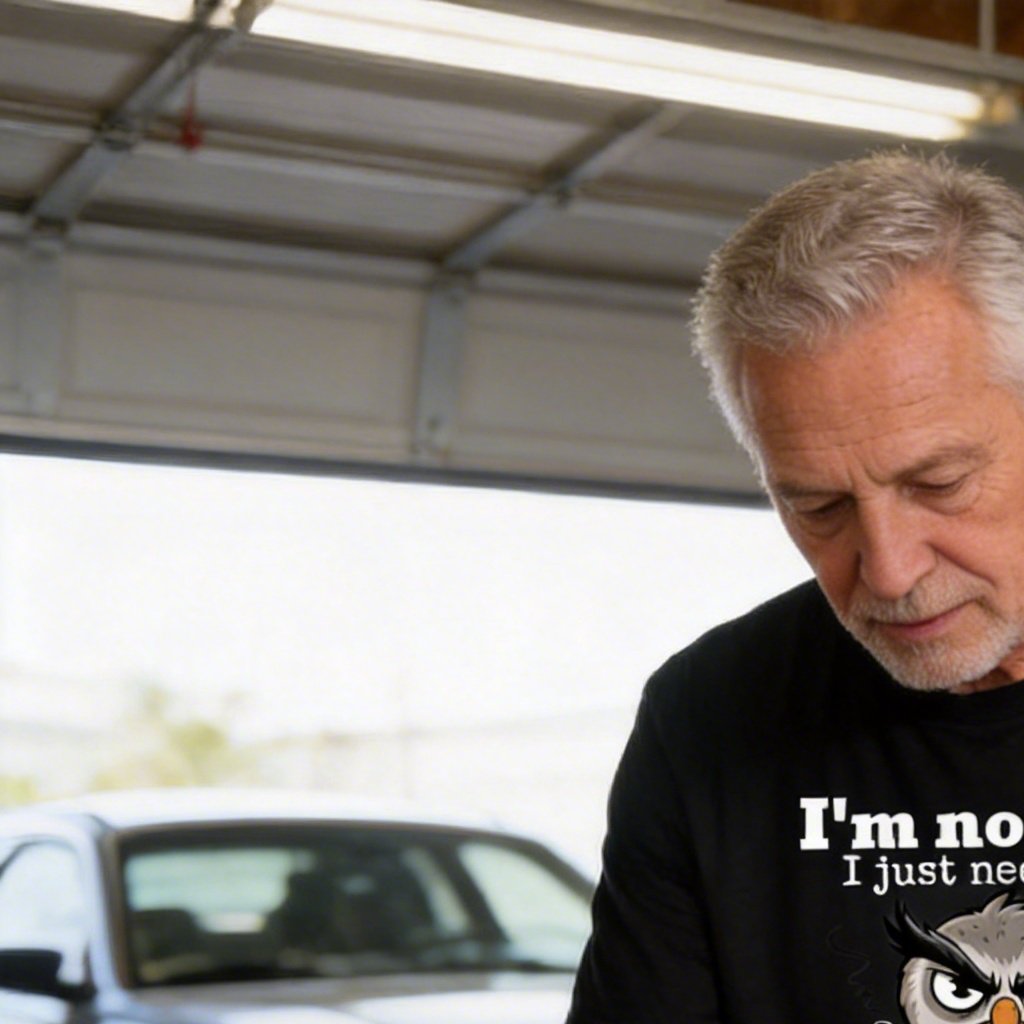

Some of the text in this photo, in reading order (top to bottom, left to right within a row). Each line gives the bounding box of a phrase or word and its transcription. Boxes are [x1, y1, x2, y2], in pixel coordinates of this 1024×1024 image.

[800, 797, 918, 850] I'm
[843, 854, 862, 886] I
[873, 855, 957, 895] just
